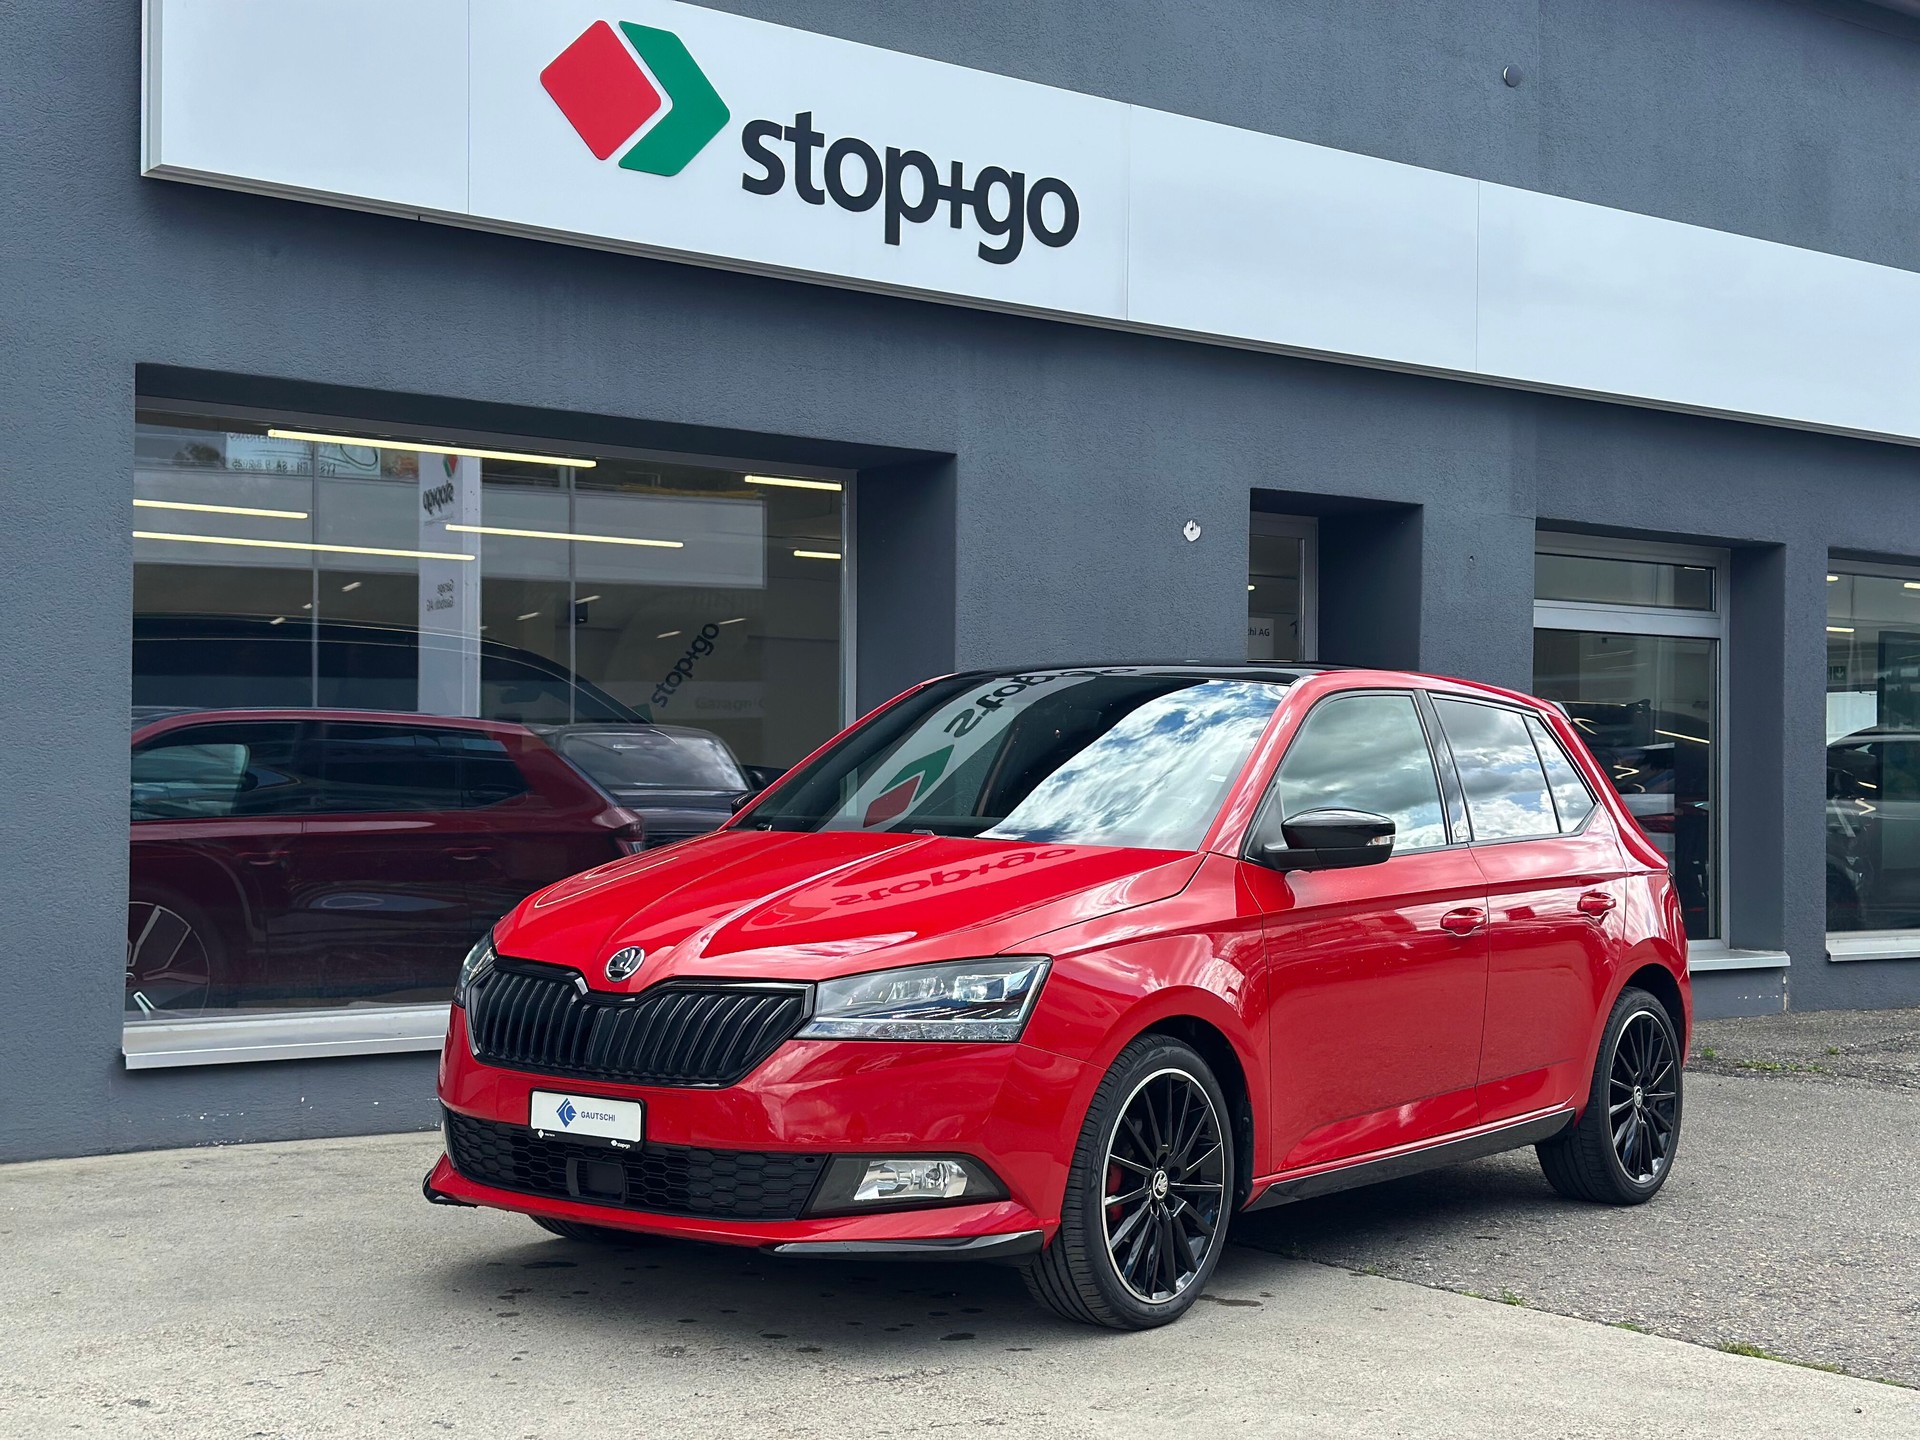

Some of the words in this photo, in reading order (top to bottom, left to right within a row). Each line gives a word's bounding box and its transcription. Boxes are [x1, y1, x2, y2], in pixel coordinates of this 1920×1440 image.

[741, 111, 1080, 265] stop+go
[1258, 628, 1270, 637] AG
[650, 623, 720, 708] stop+go
[580, 1110, 616, 1122] GAUTSCHI
